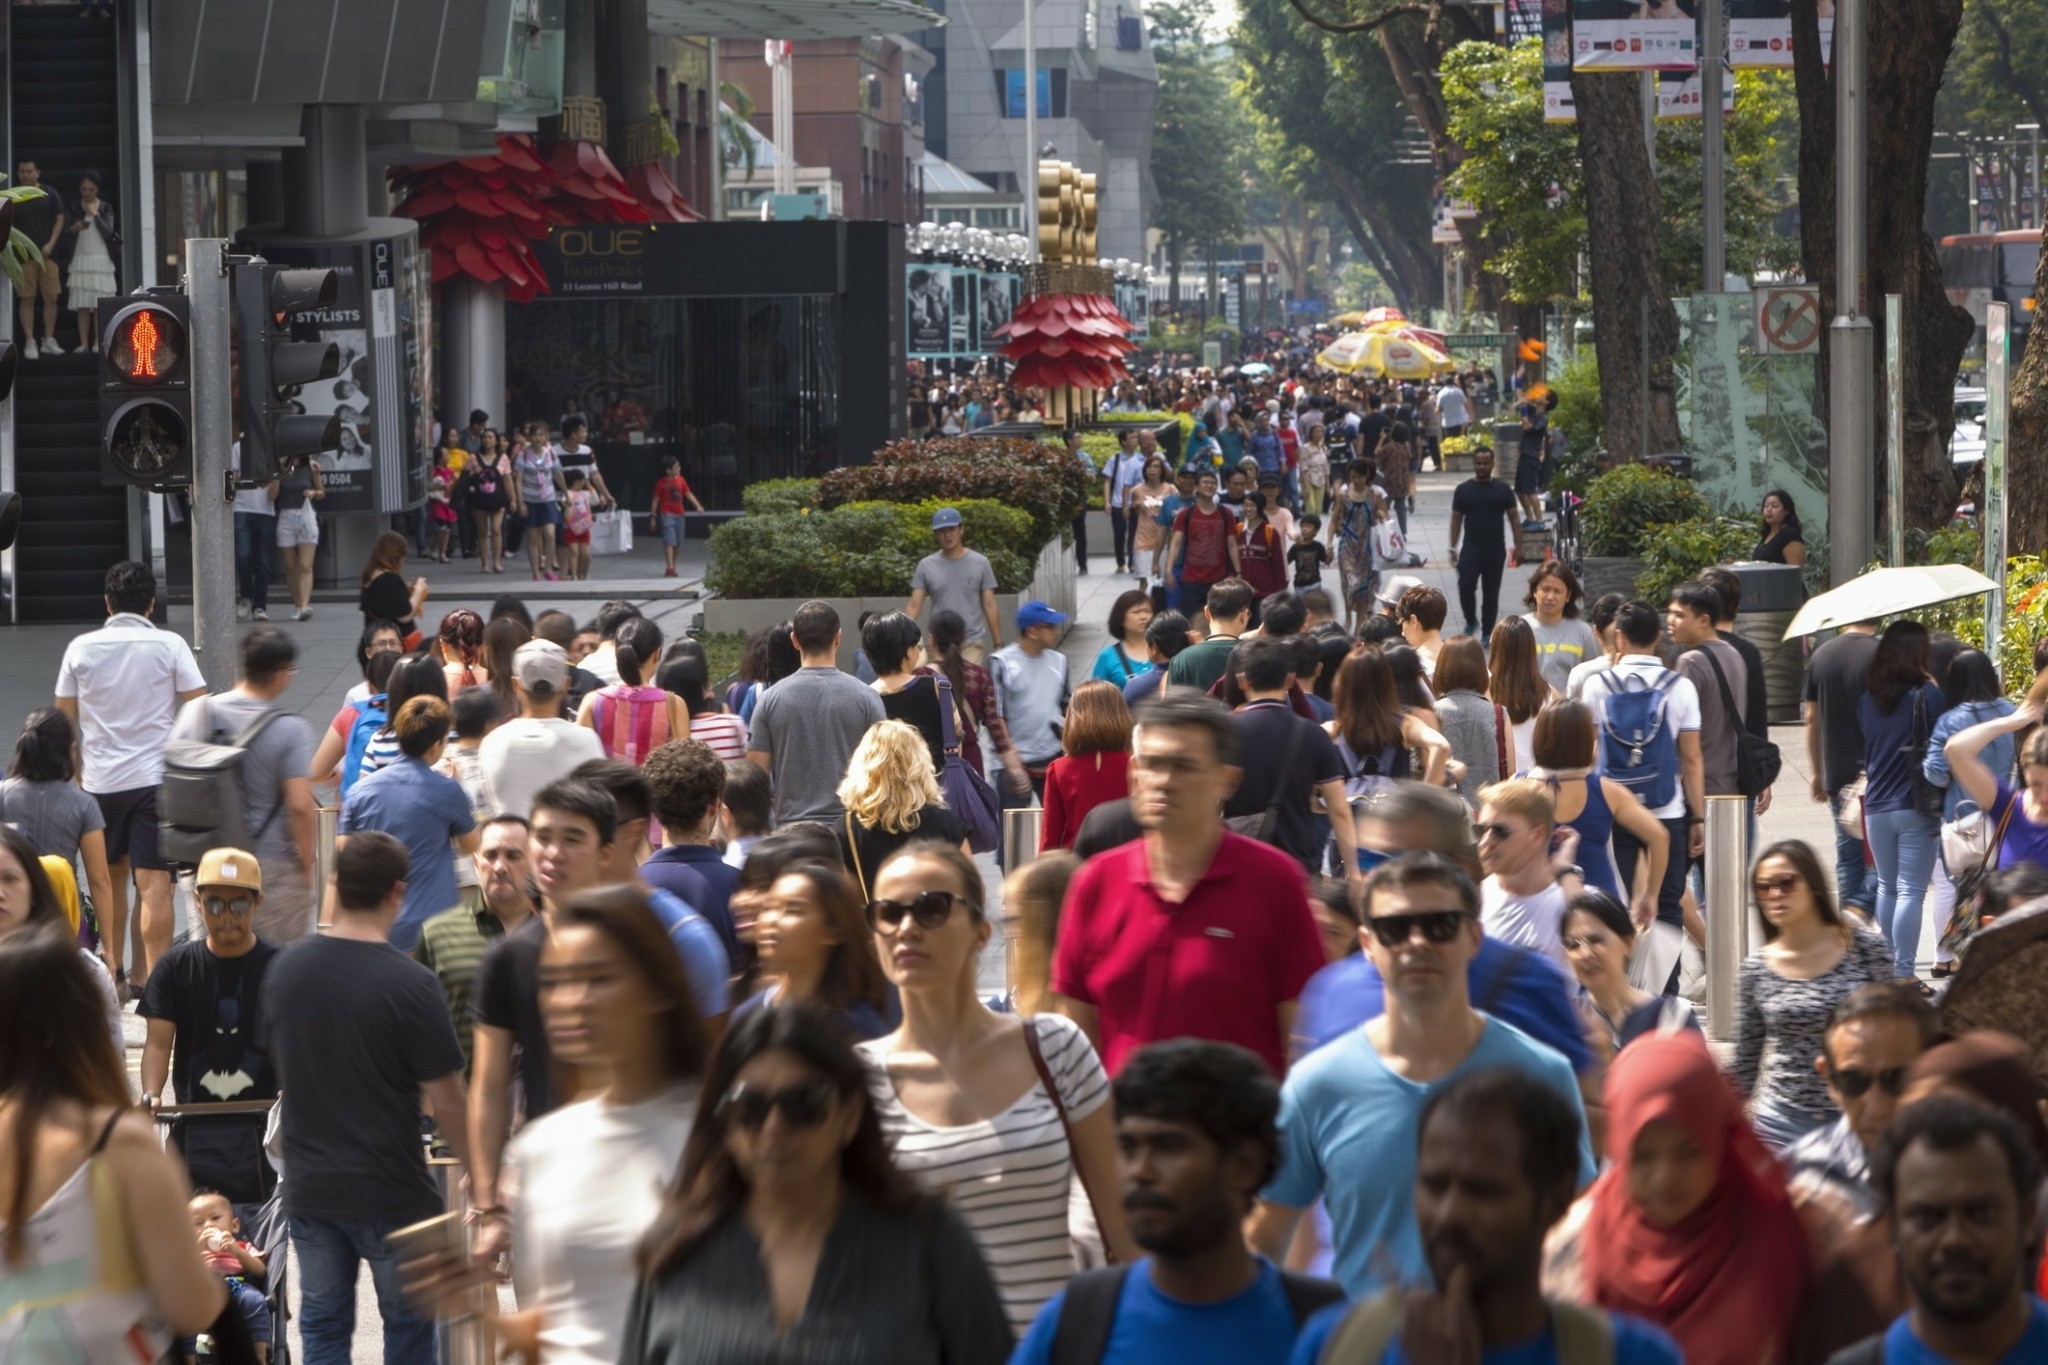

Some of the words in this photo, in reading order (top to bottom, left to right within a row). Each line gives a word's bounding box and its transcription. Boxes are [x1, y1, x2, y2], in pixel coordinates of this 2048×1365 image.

[560, 230, 642, 255] OUE
[376, 243, 388, 287] OUE
[296, 309, 360, 323] STYLISTS
